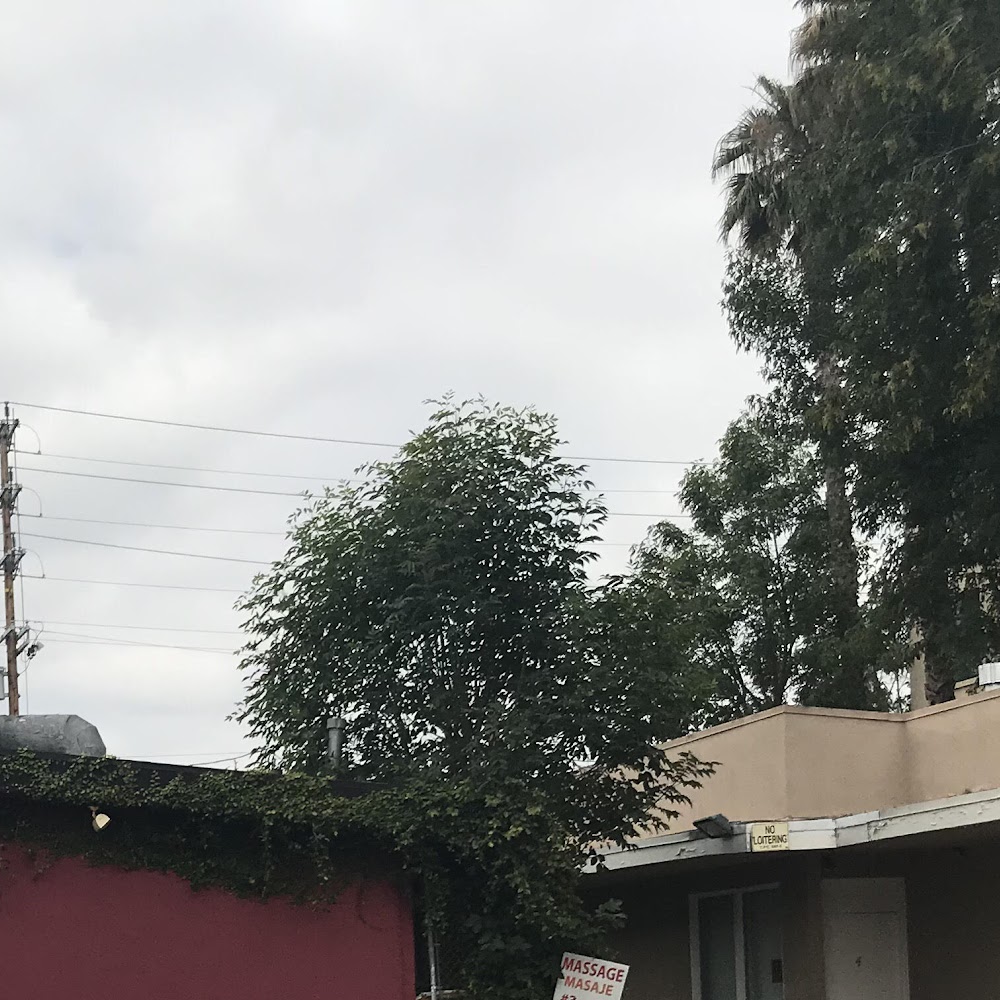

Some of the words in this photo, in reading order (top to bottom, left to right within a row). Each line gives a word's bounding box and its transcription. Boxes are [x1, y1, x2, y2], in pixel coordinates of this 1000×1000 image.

[765, 825, 775, 834] NO
[752, 835, 787, 845] LOITERING
[562, 957, 624, 982] MASSAGE
[564, 976, 613, 996] MASAJE
